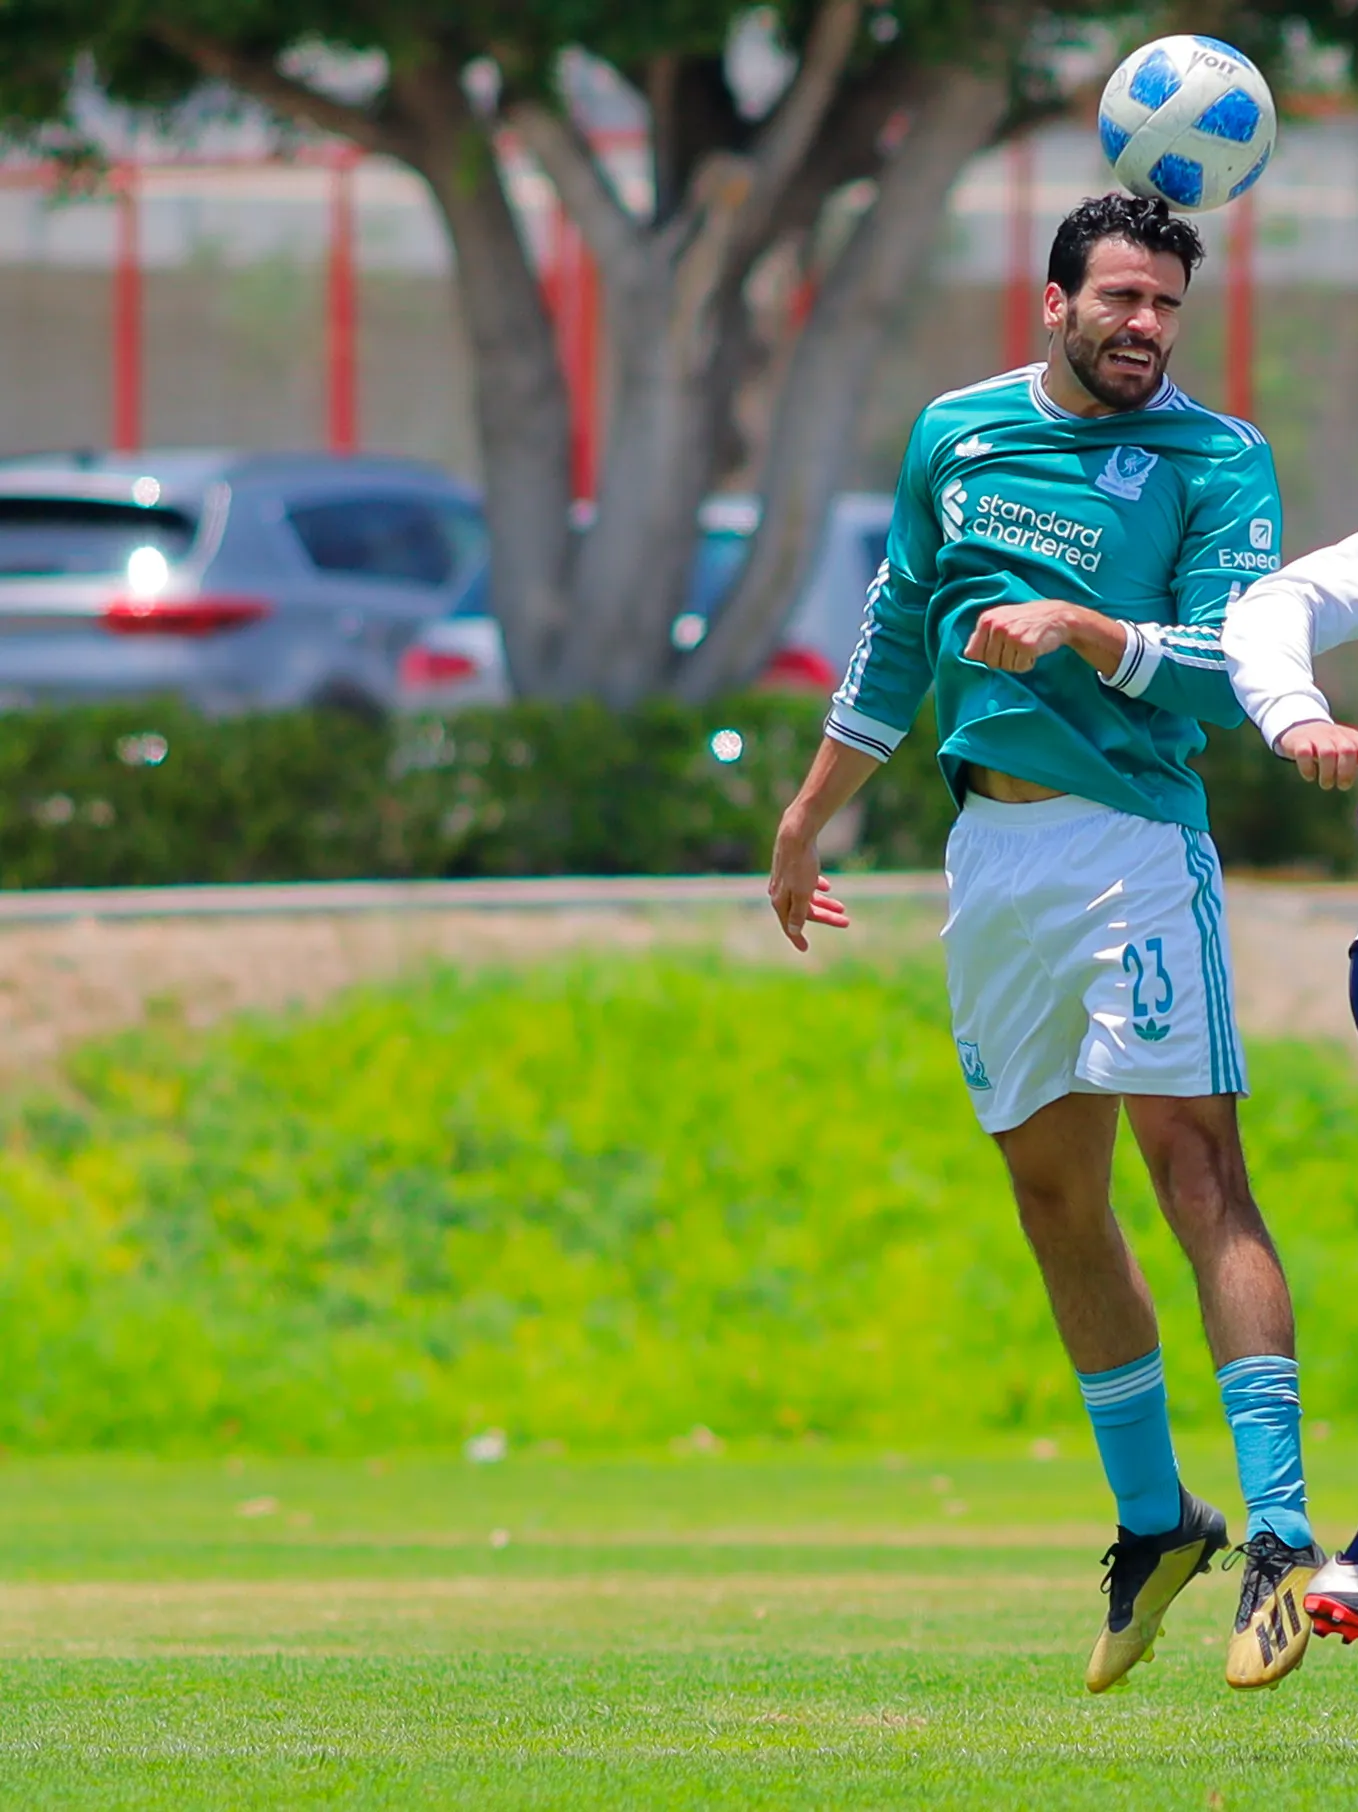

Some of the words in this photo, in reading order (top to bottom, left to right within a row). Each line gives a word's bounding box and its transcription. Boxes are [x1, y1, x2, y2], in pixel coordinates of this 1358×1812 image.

[973, 516, 1102, 573] chartered
[976, 494, 1103, 549] standard
[1121, 937, 1173, 1018] 23
